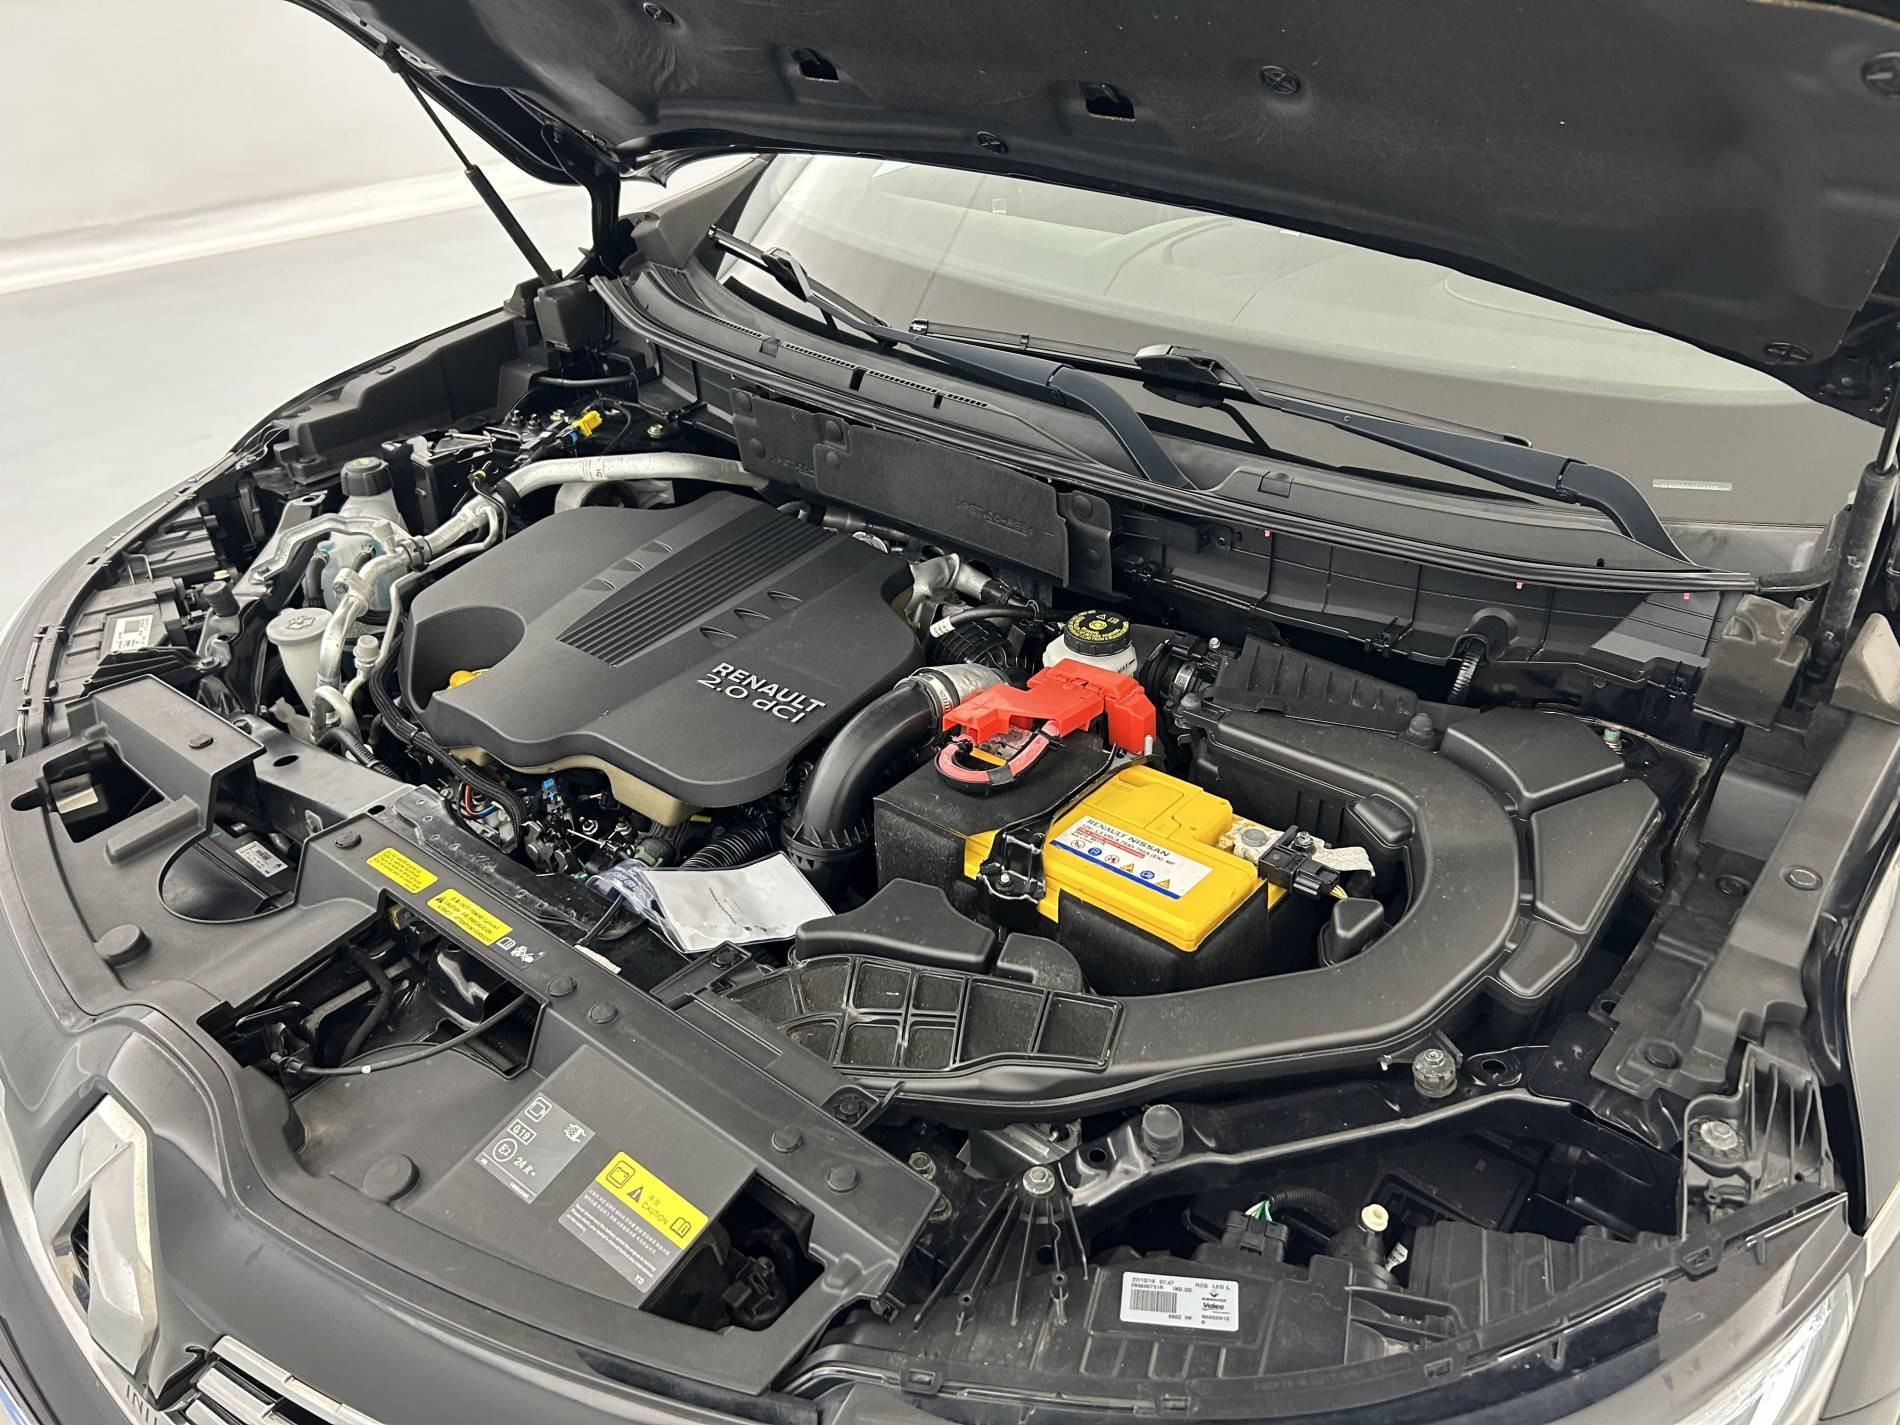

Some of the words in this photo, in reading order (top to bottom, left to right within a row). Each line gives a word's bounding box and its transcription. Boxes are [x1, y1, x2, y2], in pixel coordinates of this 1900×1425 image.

[697, 673, 749, 699] 2.0
[712, 662, 826, 712] RENAULT
[1086, 819, 1127, 838] RENAULT
[1128, 836, 1170, 857] NISSAN
[642, 1201, 669, 1224] CAUTION
[1203, 1302, 1225, 1310] Valeo
